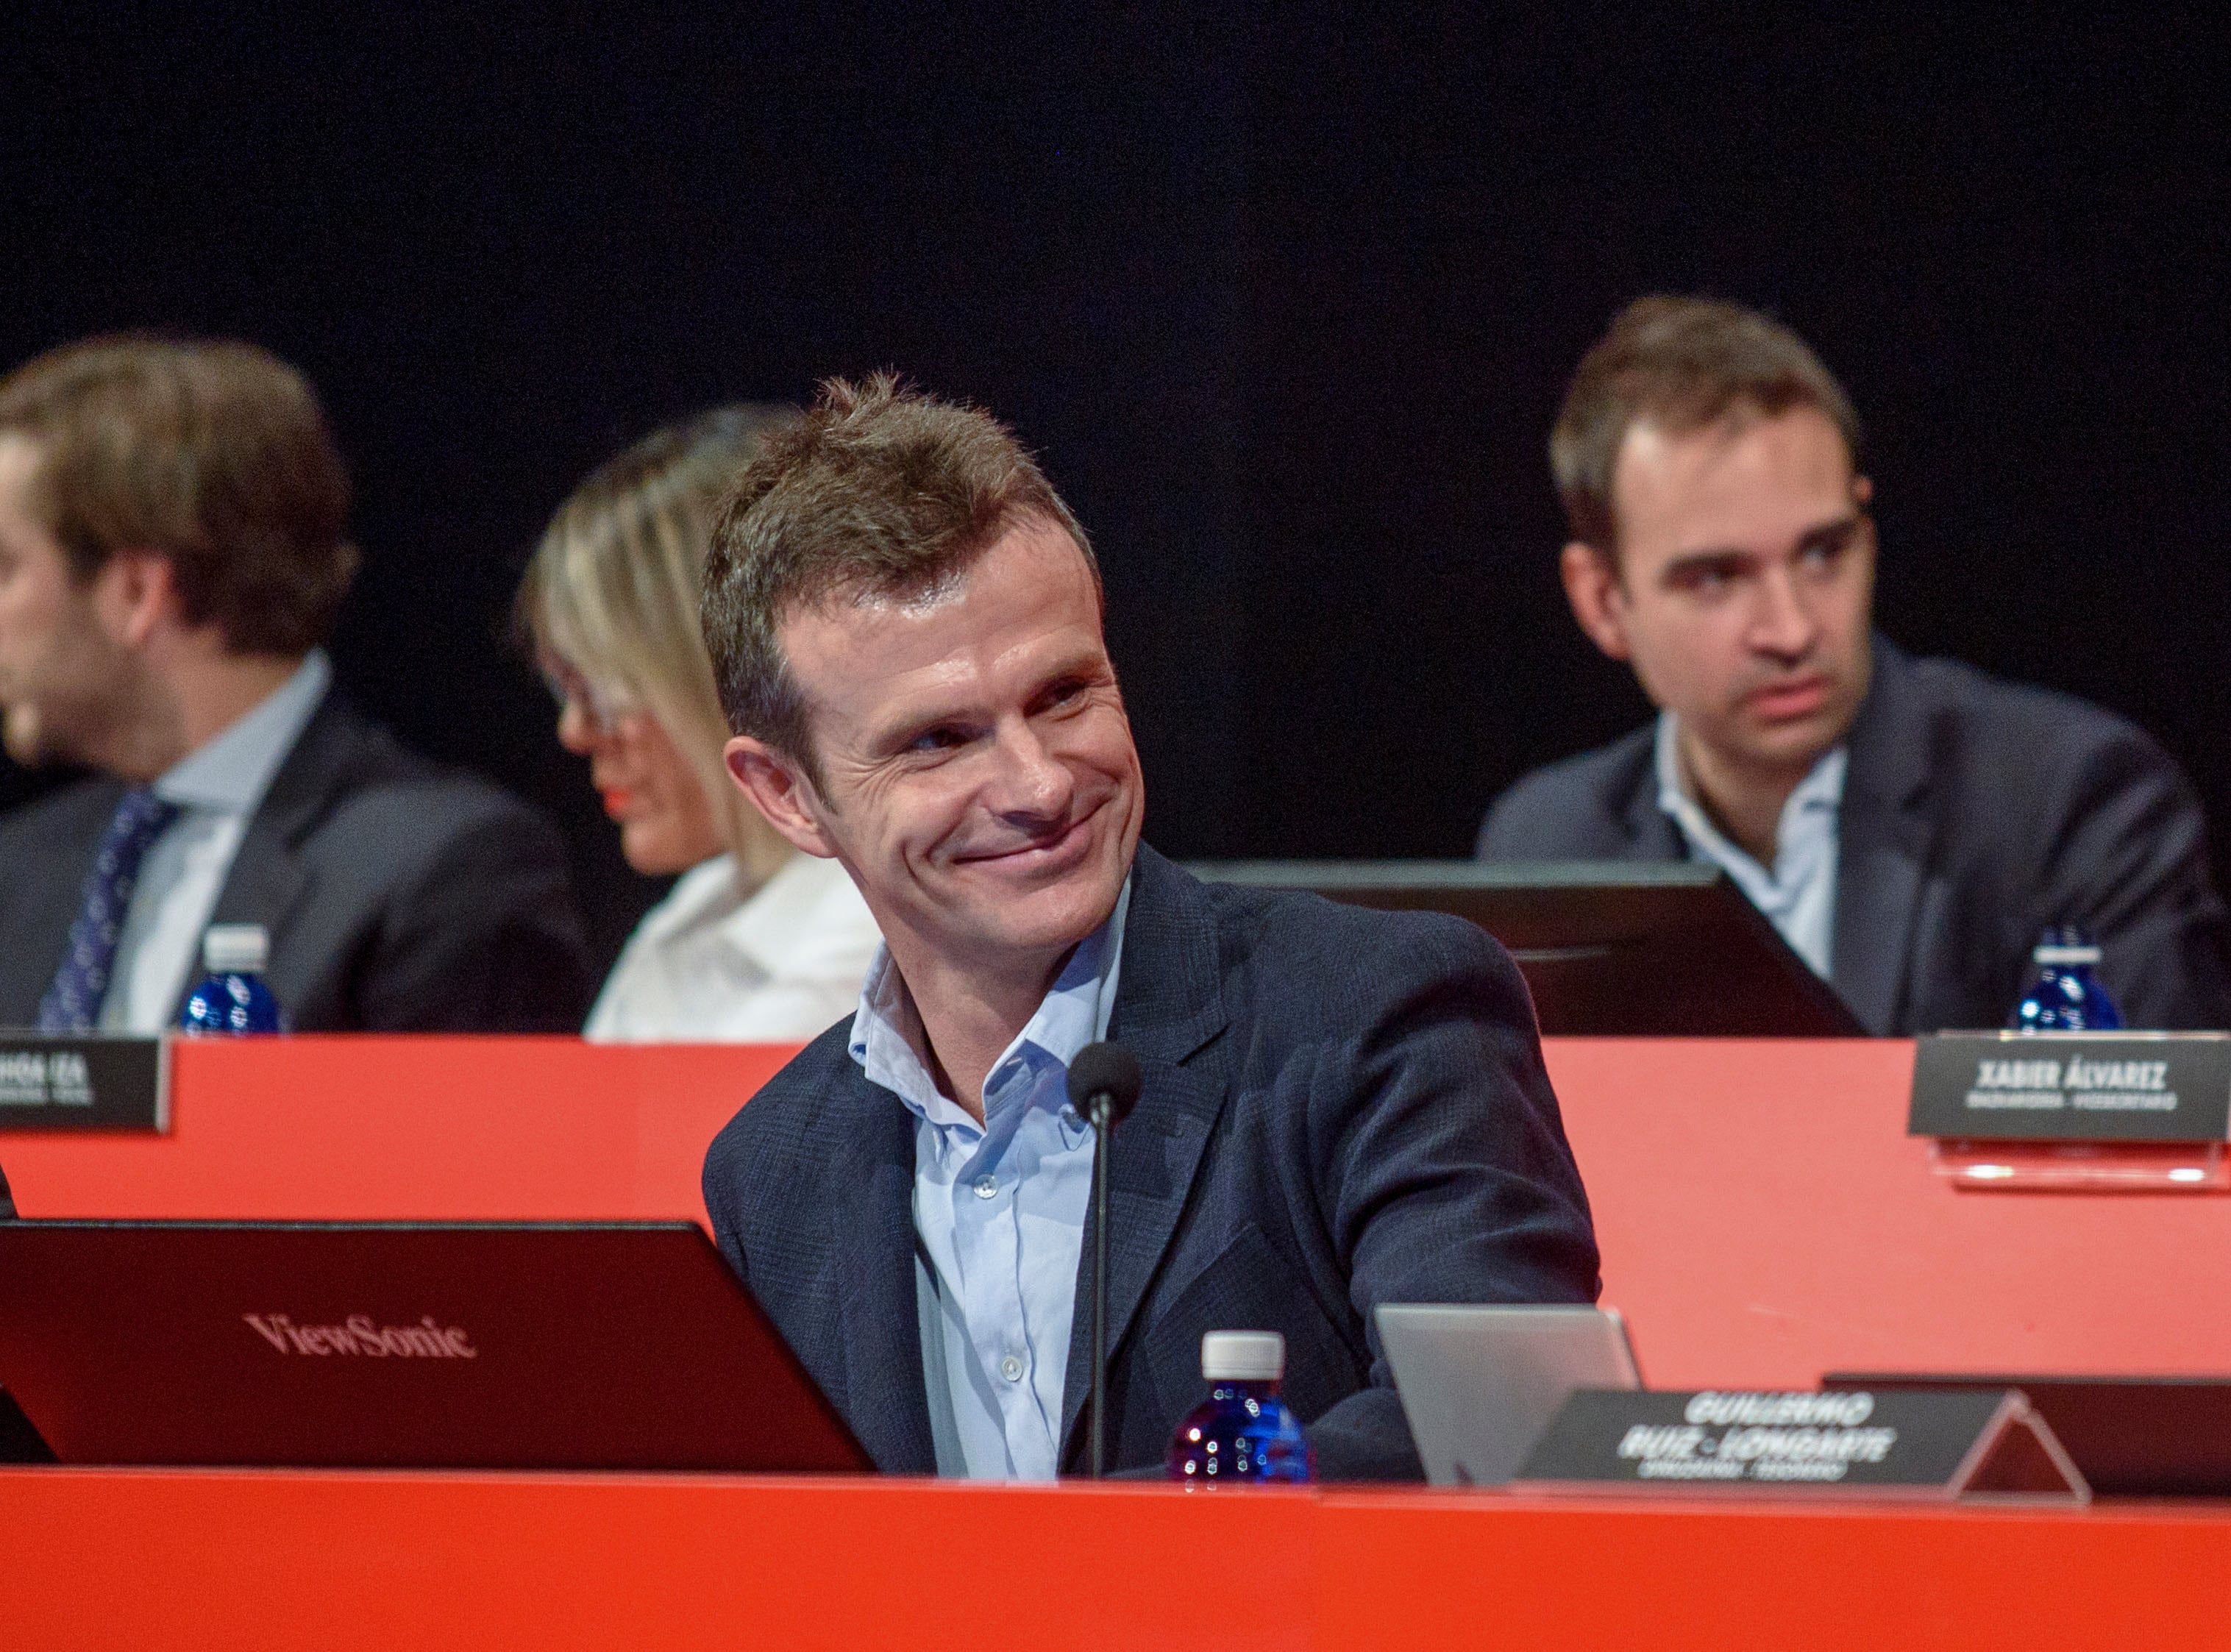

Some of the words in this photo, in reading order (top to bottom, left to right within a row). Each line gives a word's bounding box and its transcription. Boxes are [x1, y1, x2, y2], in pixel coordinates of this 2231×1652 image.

[1976, 1059, 2058, 1089] XABIER
[2063, 1053, 2168, 1090] ÁLVAREZ
[243, 1314, 477, 1358] ViewSonic
[1684, 1392, 1874, 1425] GUILLERMO
